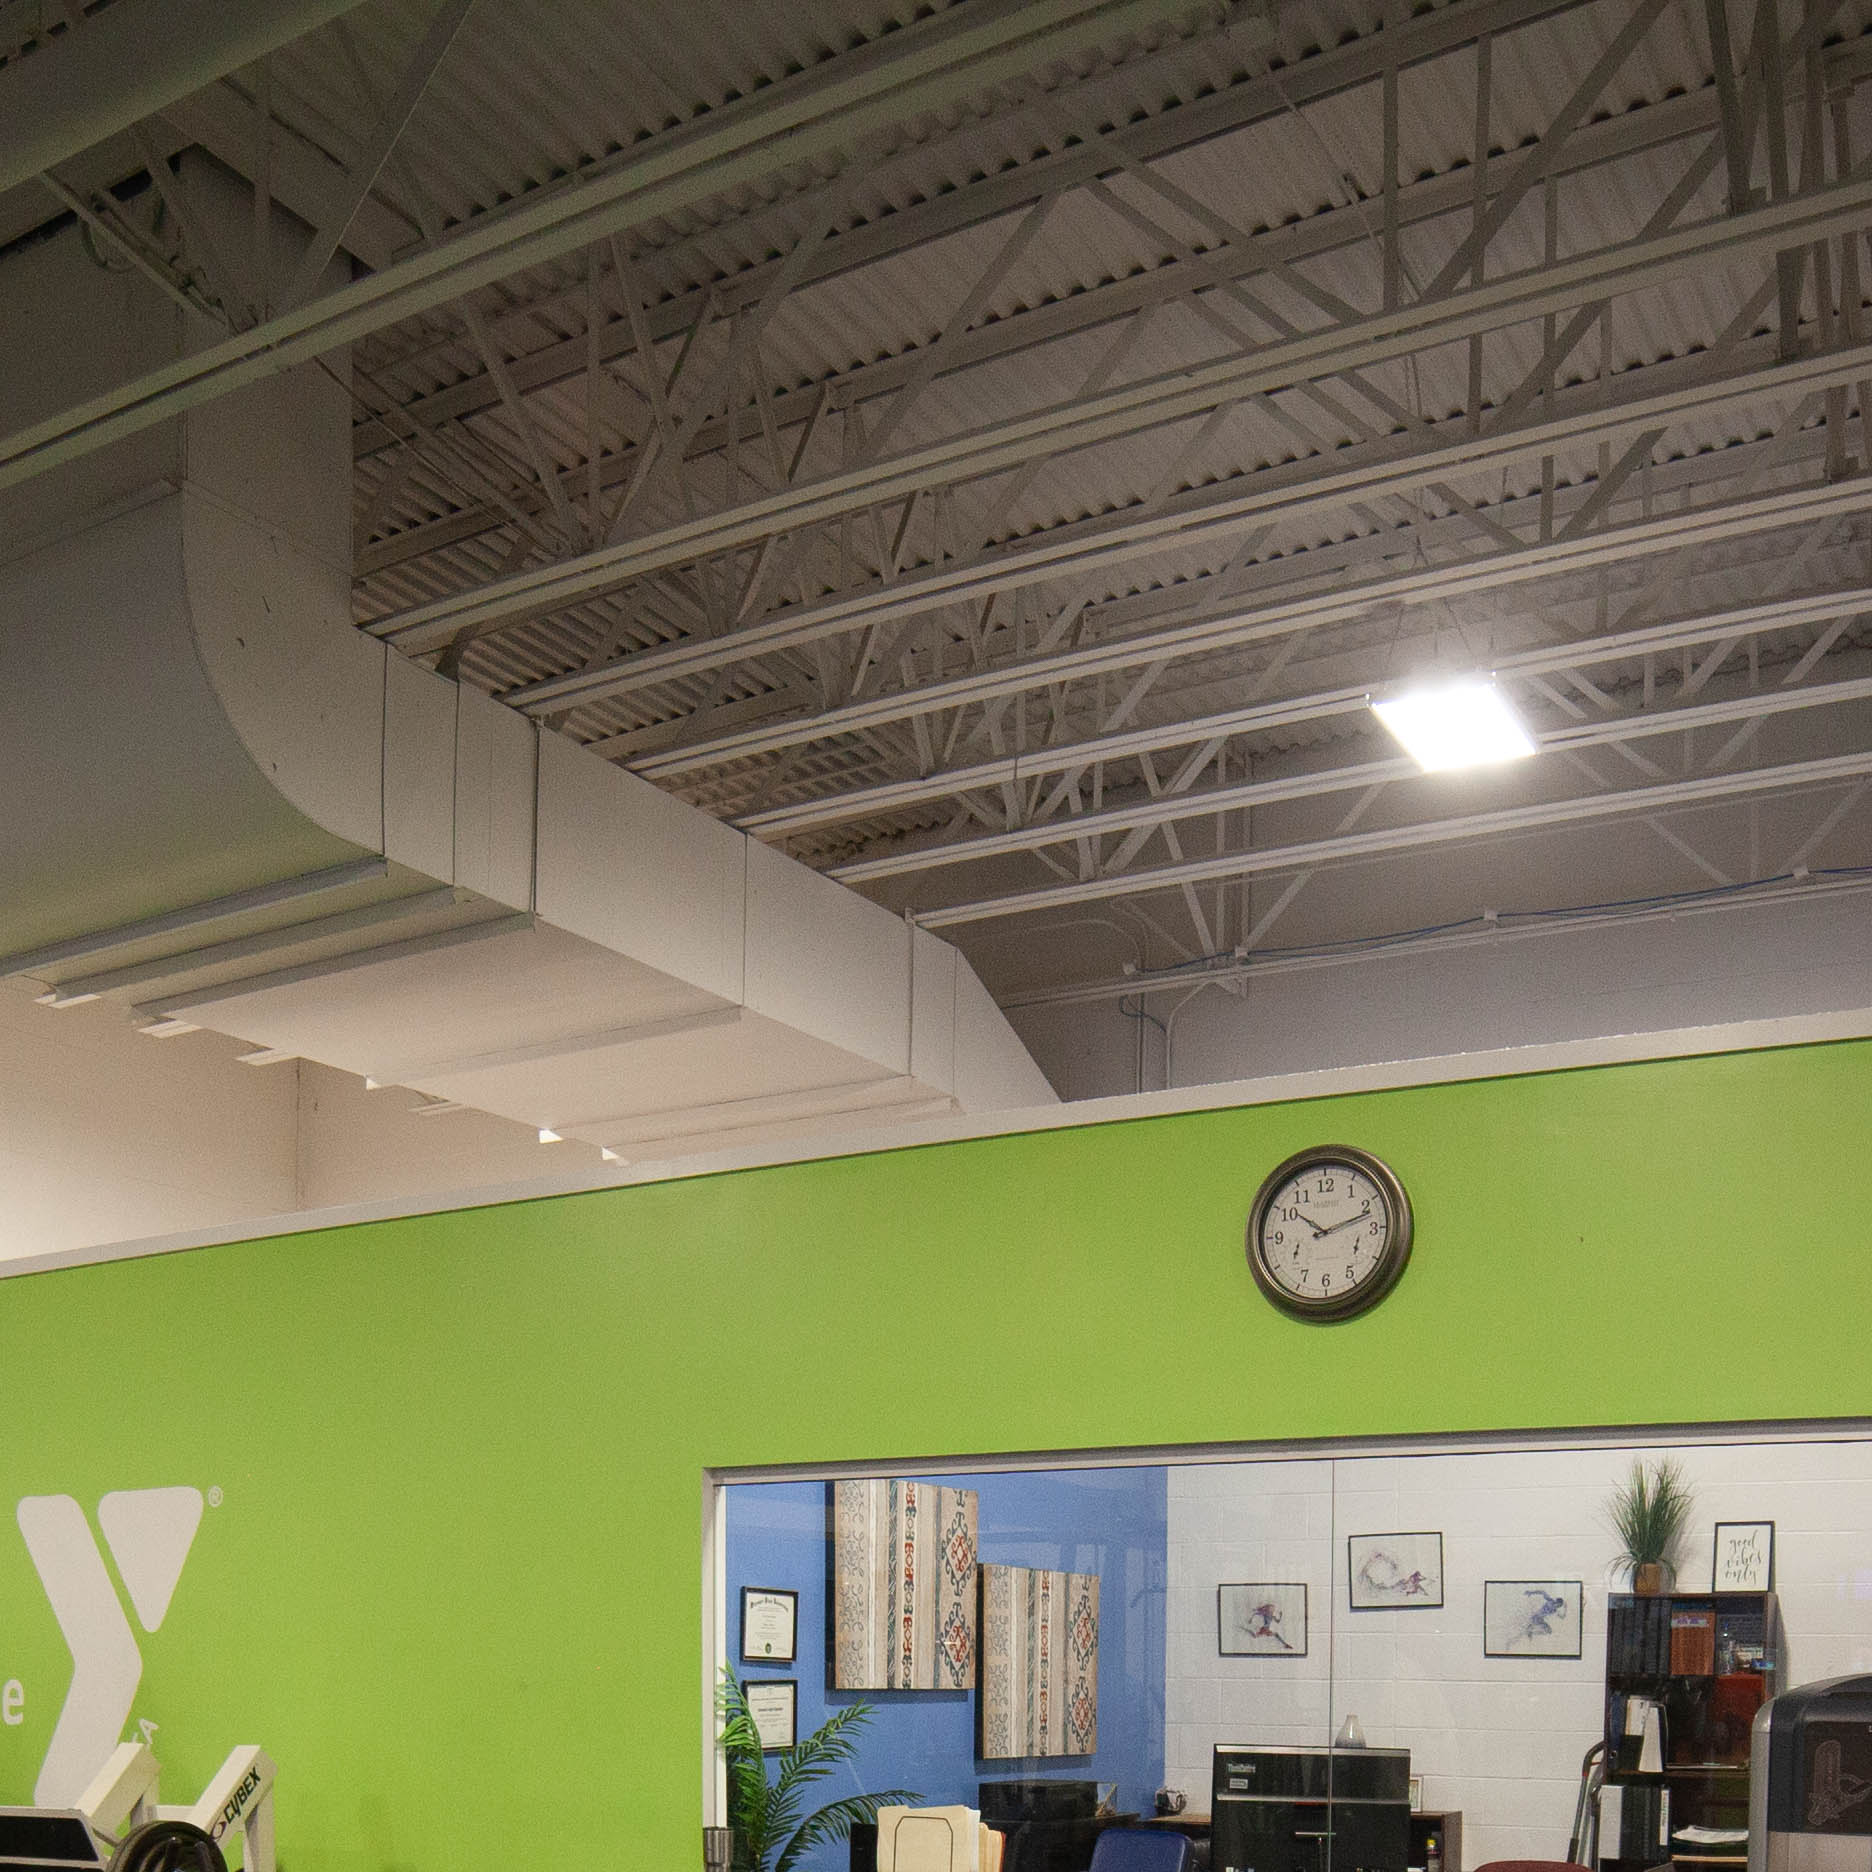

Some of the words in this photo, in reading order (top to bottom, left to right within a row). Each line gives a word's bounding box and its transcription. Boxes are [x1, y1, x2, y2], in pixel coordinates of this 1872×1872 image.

[1317, 1178, 1334, 1193] 12
[1347, 1185, 1355, 1198] 1
[1294, 1190, 1310, 1204] 11
[1281, 1207, 1298, 1221] 10
[1361, 1200, 1371, 1214] 2
[1369, 1222, 1378, 1235] 3
[1275, 1231, 1284, 1244] 9
[1300, 1269, 1309, 1283] 7
[1345, 1265, 1355, 1279] 5
[1321, 1274, 1331, 1287] 6
[16, 1486, 204, 1808] Y
[224, 1766, 261, 1824] CYBEX
